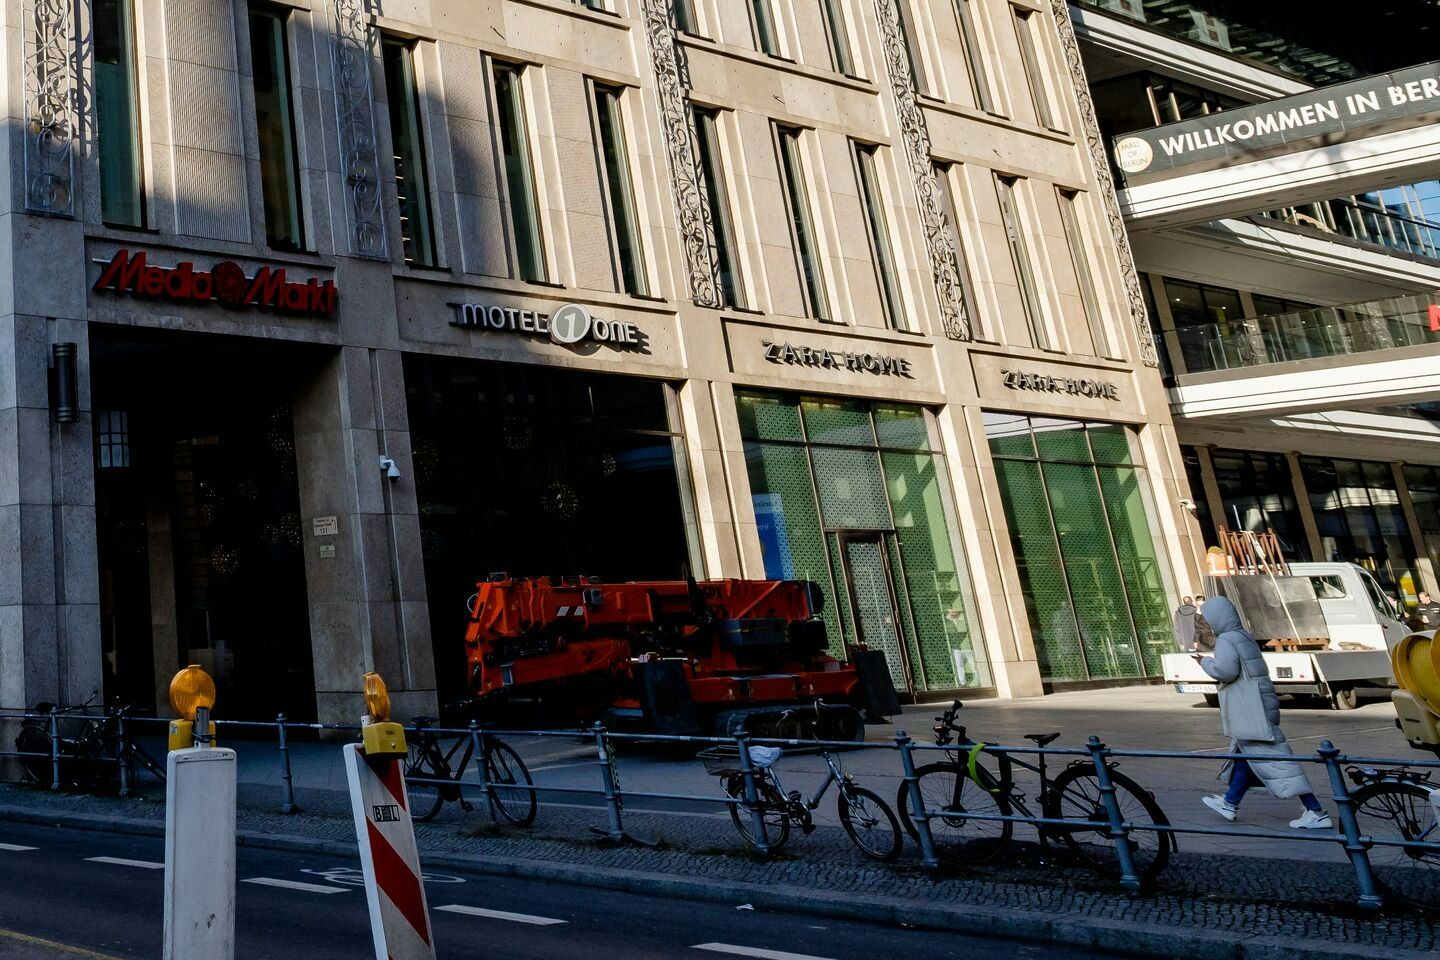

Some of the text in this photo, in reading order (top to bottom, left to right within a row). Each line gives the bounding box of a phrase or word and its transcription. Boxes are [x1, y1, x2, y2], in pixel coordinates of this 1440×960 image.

[1159, 75, 1440, 156] WILLKOMMEN IN BER
[95, 249, 337, 315] Media Markt
[761, 339, 911, 374] ZARA HOME
[1001, 369, 1118, 397] ZARA HOME
